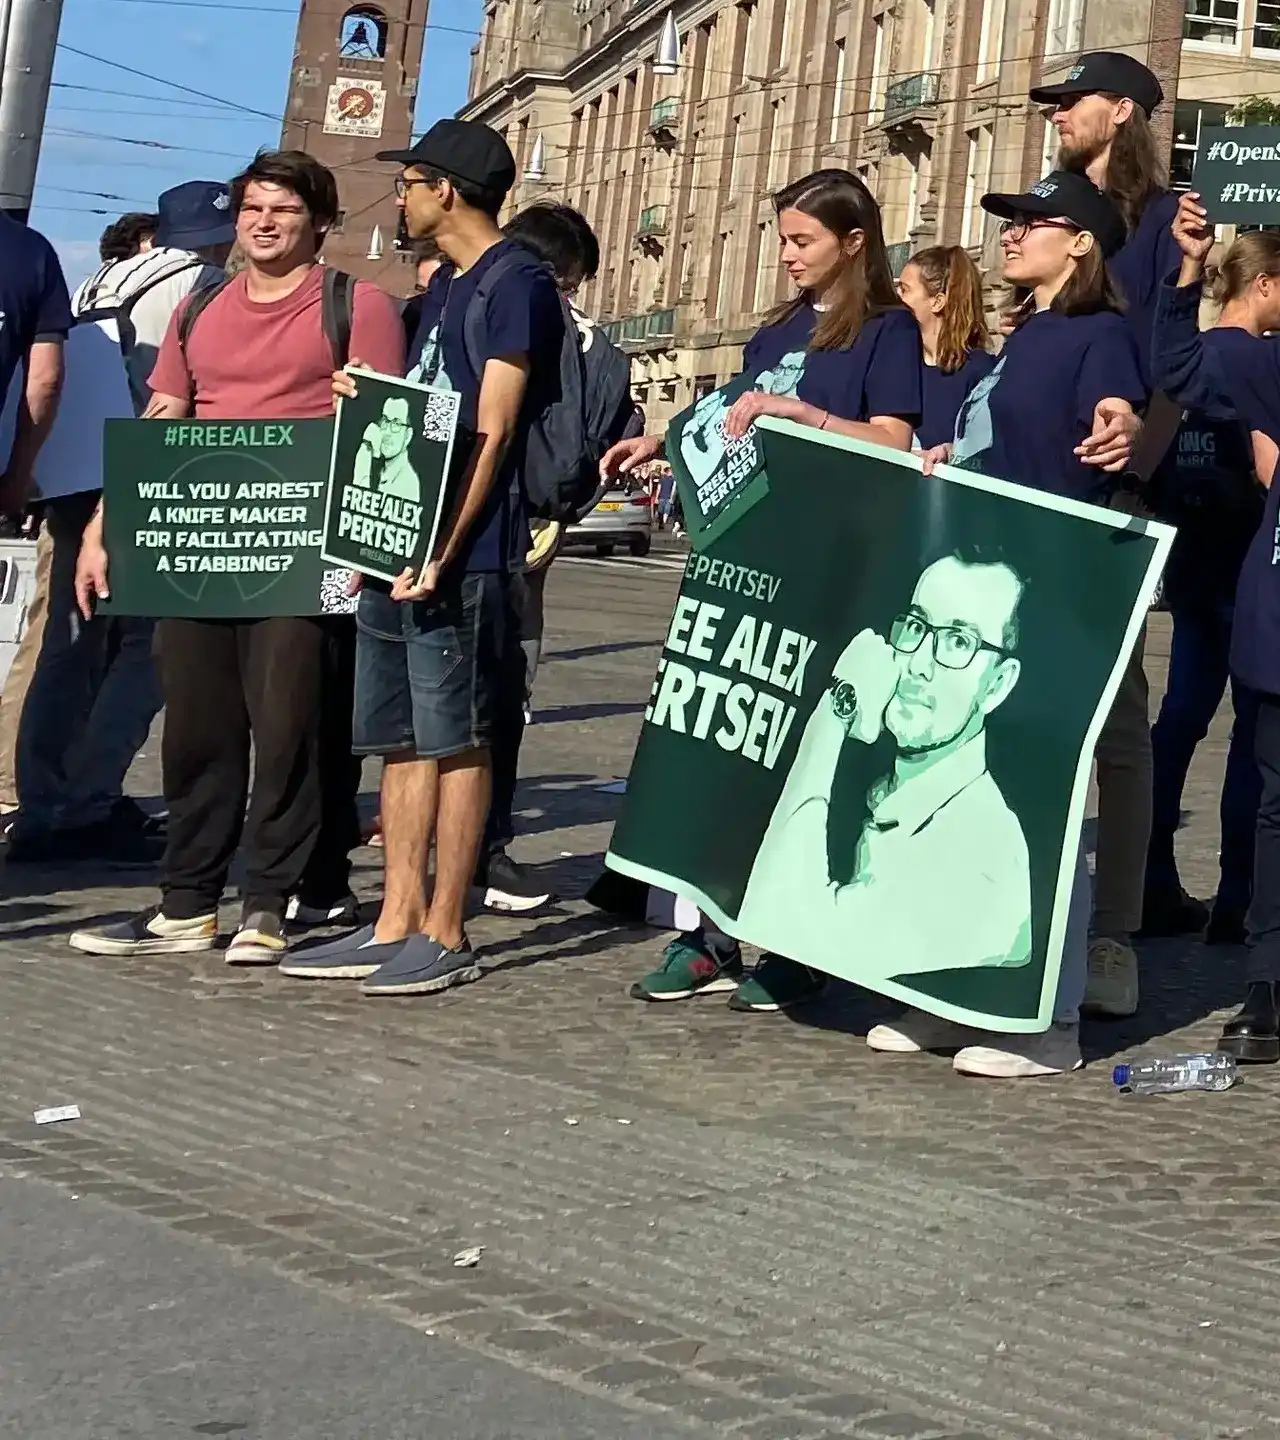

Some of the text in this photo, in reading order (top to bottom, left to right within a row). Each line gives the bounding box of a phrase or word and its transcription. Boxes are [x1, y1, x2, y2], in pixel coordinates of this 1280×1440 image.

[164, 425, 293, 447] #FREEALEX
[697, 467, 727, 502] FREE
[726, 440, 756, 475] ALEX
[700, 450, 758, 516] PERTSEV
[138, 481, 324, 500] WILL YOU ARREST
[341, 484, 423, 530] FREE ALEX
[148, 506, 307, 524] A KNIFE MAKER
[135, 530, 323, 548] FOR FACILITATING
[338, 510, 420, 559] PERTSEV
[156, 554, 294, 573] A STABBING?
[719, 614, 818, 697] ALEX
